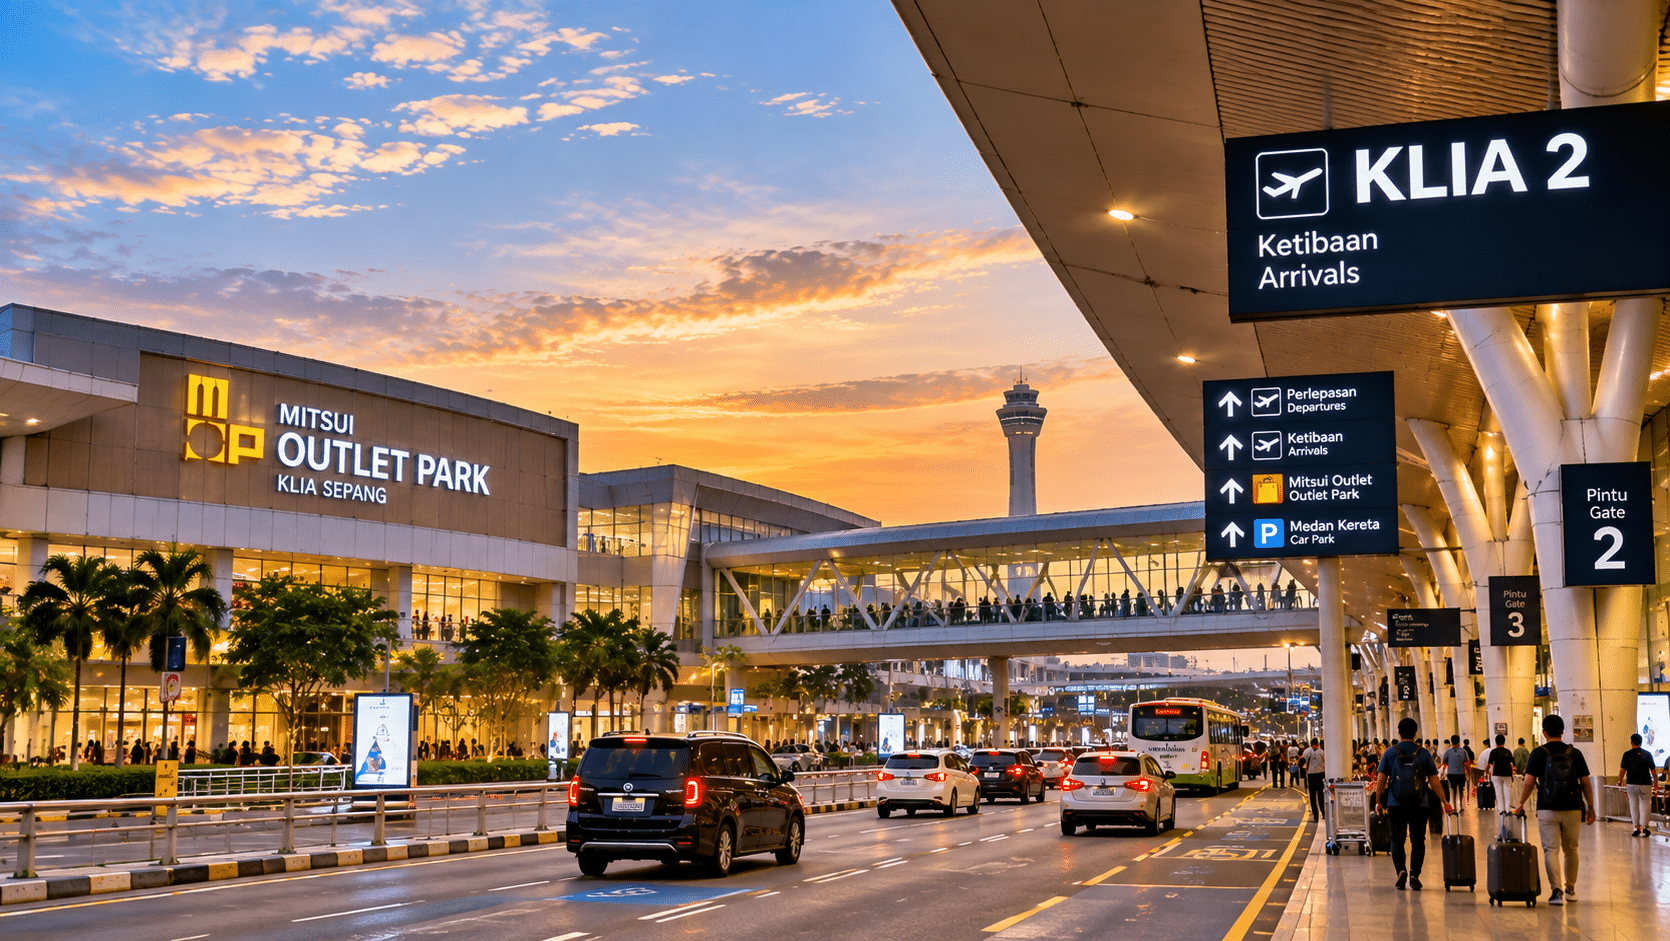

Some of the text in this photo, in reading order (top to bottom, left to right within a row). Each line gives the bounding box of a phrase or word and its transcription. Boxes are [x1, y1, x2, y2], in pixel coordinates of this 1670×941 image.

[1355, 132, 1590, 204] KLIA 2
[1258, 230, 1378, 259] Ketibaan
[1258, 260, 1360, 290] Arrivals
[1287, 387, 1357, 402] Perlepasan
[1287, 402, 1347, 415] Departures
[279, 402, 354, 436] MITSUI
[1287, 431, 1344, 444] Ketibaan
[1287, 445, 1329, 457] Arrivals
[276, 431, 491, 496] OUTLET PARK
[1289, 473, 1373, 488] Mitsui Outlet
[277, 473, 388, 505] KLIA SEPANG
[1289, 488, 1360, 501] Outlet Park
[1586, 487, 1628, 502] Pintu
[1589, 504, 1627, 519] Gate
[1290, 518, 1380, 532] Medan Kereta
[1260, 523, 1279, 545] P
[1290, 533, 1335, 545] Car Park
[1593, 526, 1627, 570] 2
[1503, 590, 1527, 598] Pintu
[1505, 600, 1526, 608] Gate
[1507, 611, 1525, 638] 3
